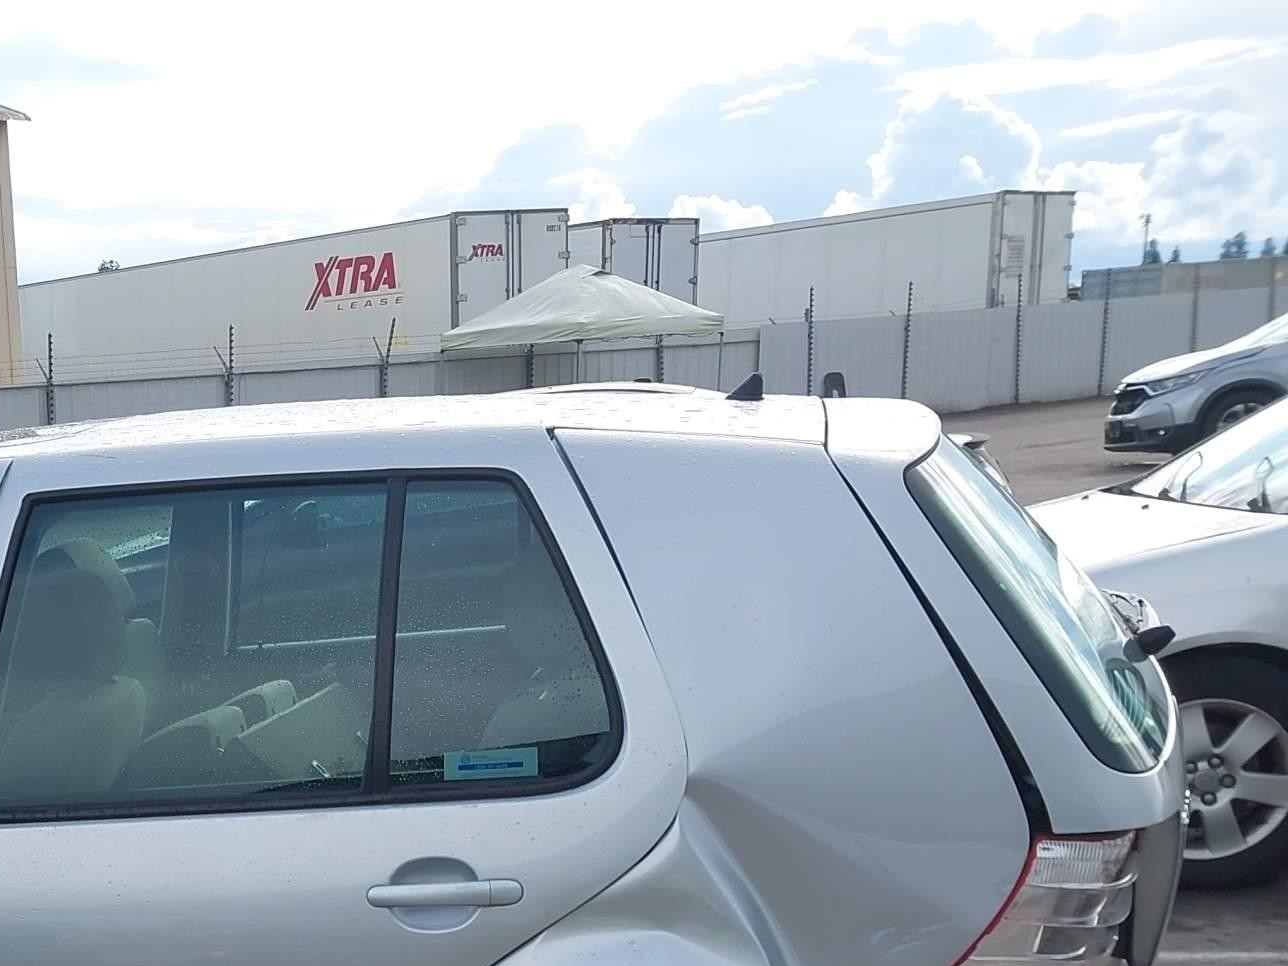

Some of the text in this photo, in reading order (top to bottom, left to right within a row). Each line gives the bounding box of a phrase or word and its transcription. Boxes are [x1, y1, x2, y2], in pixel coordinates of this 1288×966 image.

[467, 244, 504, 261] XTRA
[305, 252, 397, 311] XTRA
[337, 296, 404, 311] LEASE
